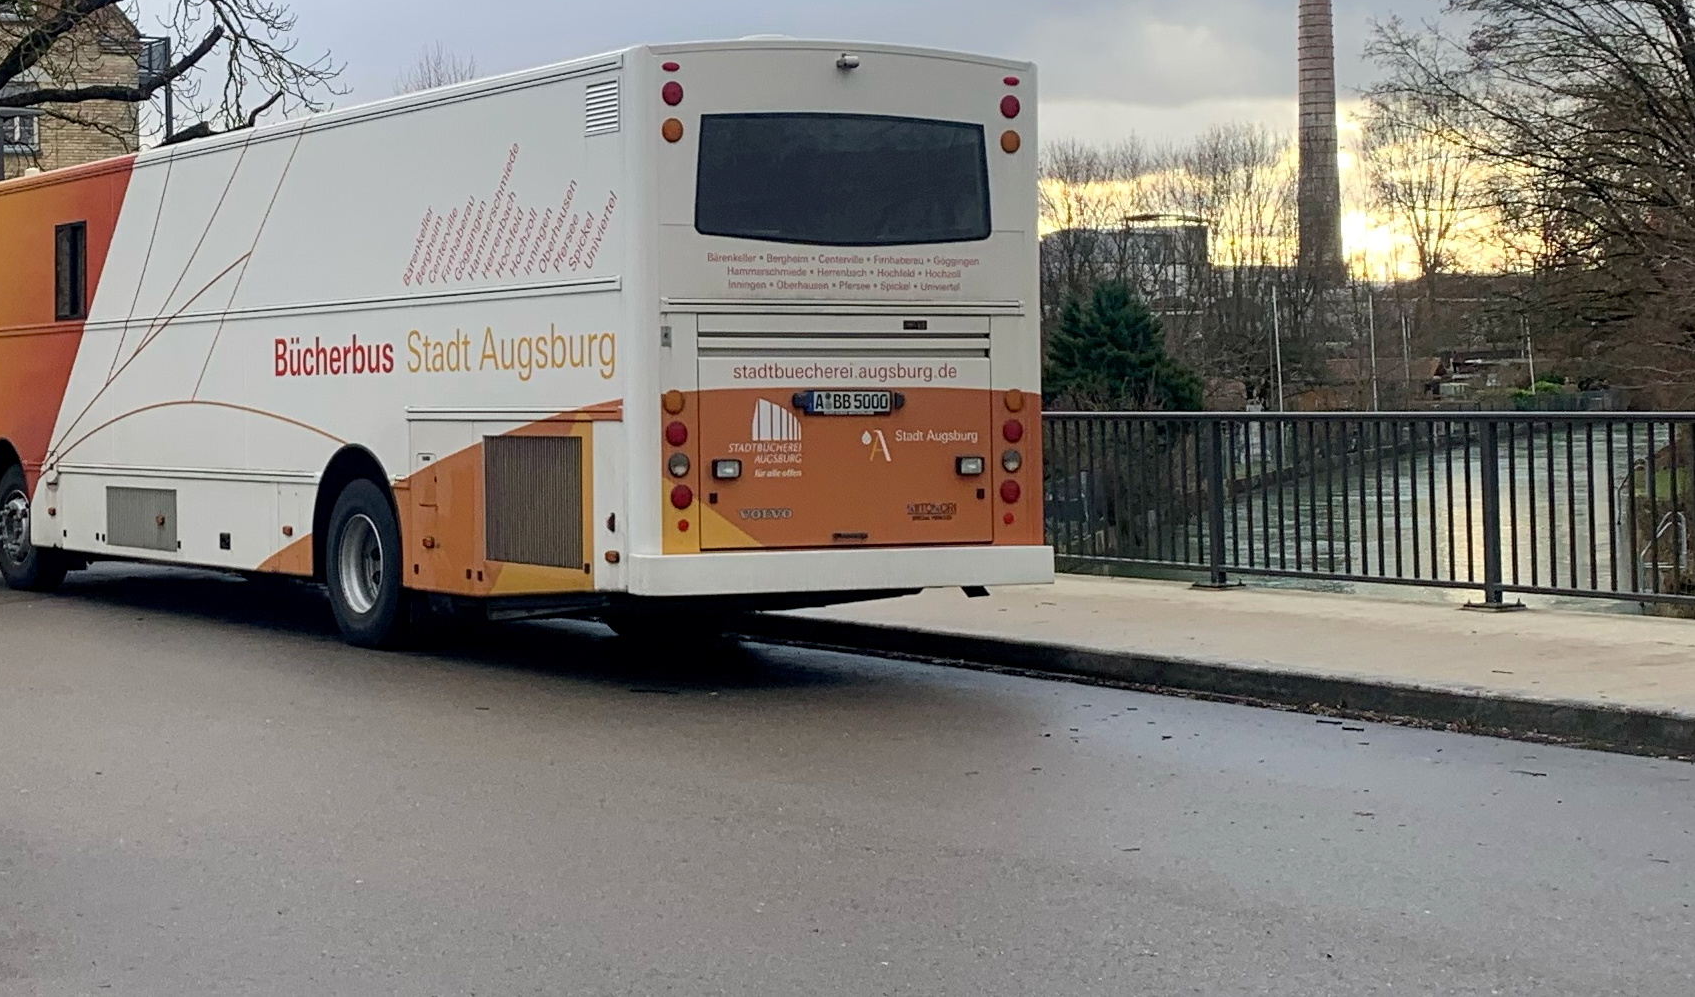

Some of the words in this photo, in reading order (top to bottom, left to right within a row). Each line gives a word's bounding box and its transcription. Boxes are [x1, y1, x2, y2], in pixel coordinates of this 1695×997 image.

[441, 195, 475, 283] Firnhaberau
[455, 200, 486, 281] Göggingen
[467, 143, 519, 281] Hammerschmiede
[481, 191, 516, 279] Herrenbach
[495, 206, 524, 278] Hochfeld
[509, 207, 538, 277] Hochzoll
[523, 207, 553, 275] Inningen
[538, 179, 577, 274] Oberhausen
[553, 214, 579, 273] Pfersee
[568, 211, 594, 272] Spickel
[584, 190, 618, 269] Univiertel
[403, 205, 433, 286] Bärenkeller
[416, 215, 443, 285] Bergheim
[428, 207, 458, 283] Centerville
[707, 252, 757, 262] Bärenkeller
[766, 253, 809, 265] Bergheim
[818, 254, 864, 264] Centerville
[873, 255, 924, 265] Firnhaberau
[933, 255, 980, 267] Göggingen
[727, 266, 807, 277] Hammerschmiede
[817, 267, 867, 277] Herrenbach
[877, 268, 916, 278] Hochfeld
[925, 268, 962, 278] Hochzoll
[728, 279, 766, 291] Inningen
[776, 280, 829, 290] Oberhausen
[839, 280, 871, 290] Pfersee
[880, 282, 911, 292] Spickel
[920, 282, 961, 291] Univiertel
[274, 333, 394, 377] Bücherbus
[407, 328, 472, 374] Stadt
[479, 322, 617, 382] Augsburg
[733, 362, 958, 383] stadtbuecherei.augsburg.de
[853, 393, 889, 410] 5000
[728, 442, 802, 454] STADTBÜCHEREI
[754, 453, 802, 464] AUGSBURG
[895, 429, 924, 442] Stadt
[926, 429, 979, 444] Augsburg
[738, 508, 793, 520] VOLVO
